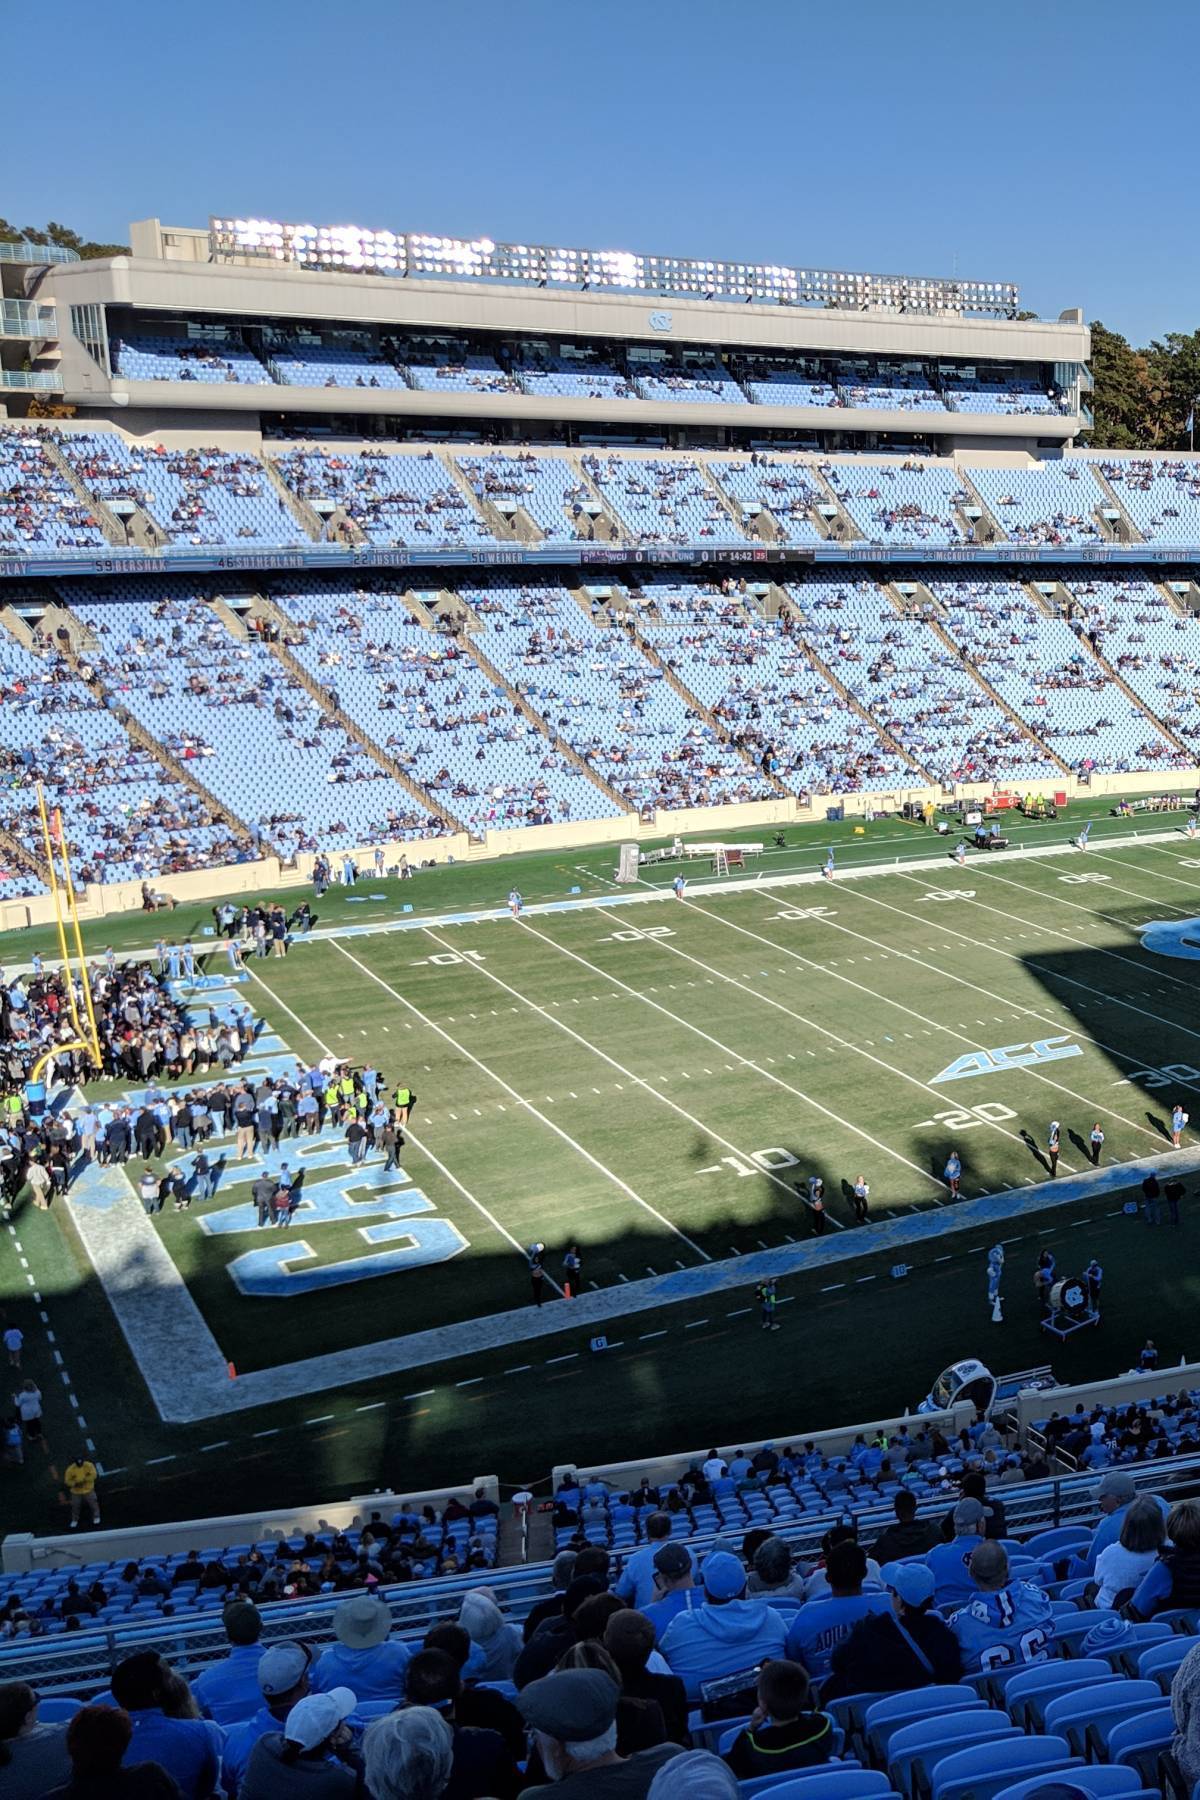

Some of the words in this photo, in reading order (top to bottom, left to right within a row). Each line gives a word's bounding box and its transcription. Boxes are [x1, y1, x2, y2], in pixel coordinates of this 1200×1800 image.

[236, 555, 304, 569] SUTHERLAND
[354, 553, 368, 565] 22
[371, 553, 412, 565] JUSTICE
[472, 552, 485, 564] 50
[487, 552, 523, 564] WEINER
[609, 552, 627, 561] WCU
[636, 551, 643, 562] 0
[702, 551, 709, 562] 0
[730, 551, 752, 562] 14:42
[96, 560, 112, 573] 59
[926, 1035, 1084, 1085] ACC
[931, 1103, 1019, 1130] 20
[720, 1147, 801, 1177] 10
